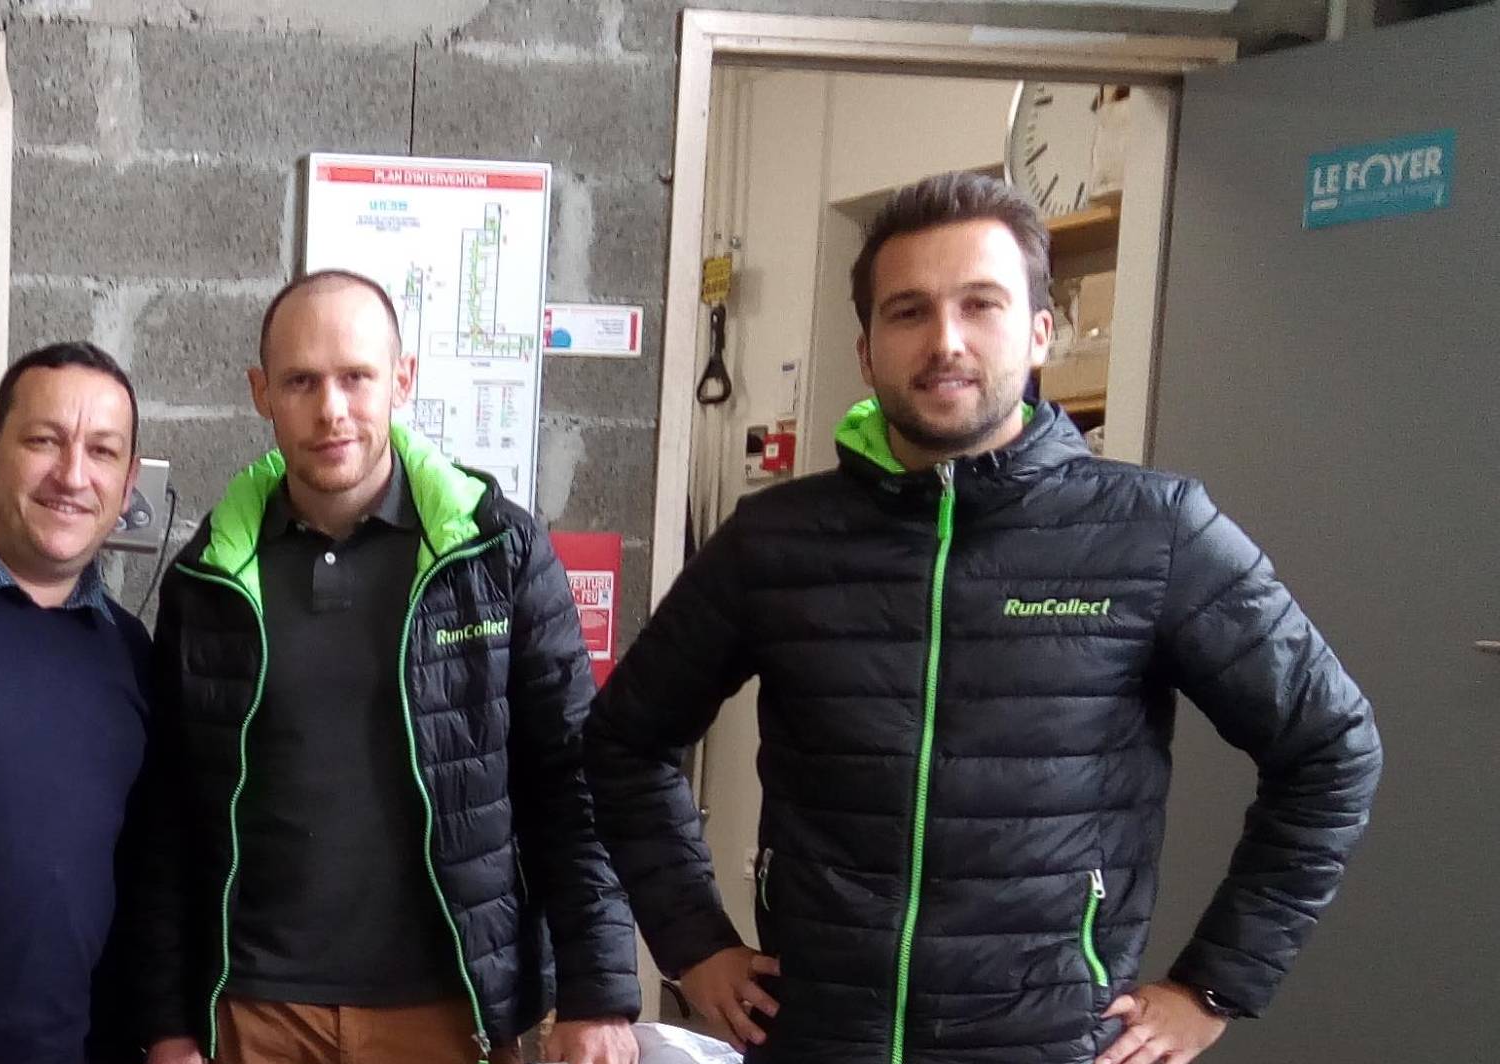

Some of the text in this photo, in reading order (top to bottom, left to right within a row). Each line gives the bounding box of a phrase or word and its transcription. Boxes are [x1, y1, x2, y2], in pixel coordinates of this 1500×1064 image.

[374, 168, 487, 187] PLAN D'INTERVENTION
[1313, 165, 1341, 195] LE
[1345, 147, 1443, 190] FOYER
[1004, 598, 1111, 616] RunCollect
[436, 617, 509, 646] RunCollect
